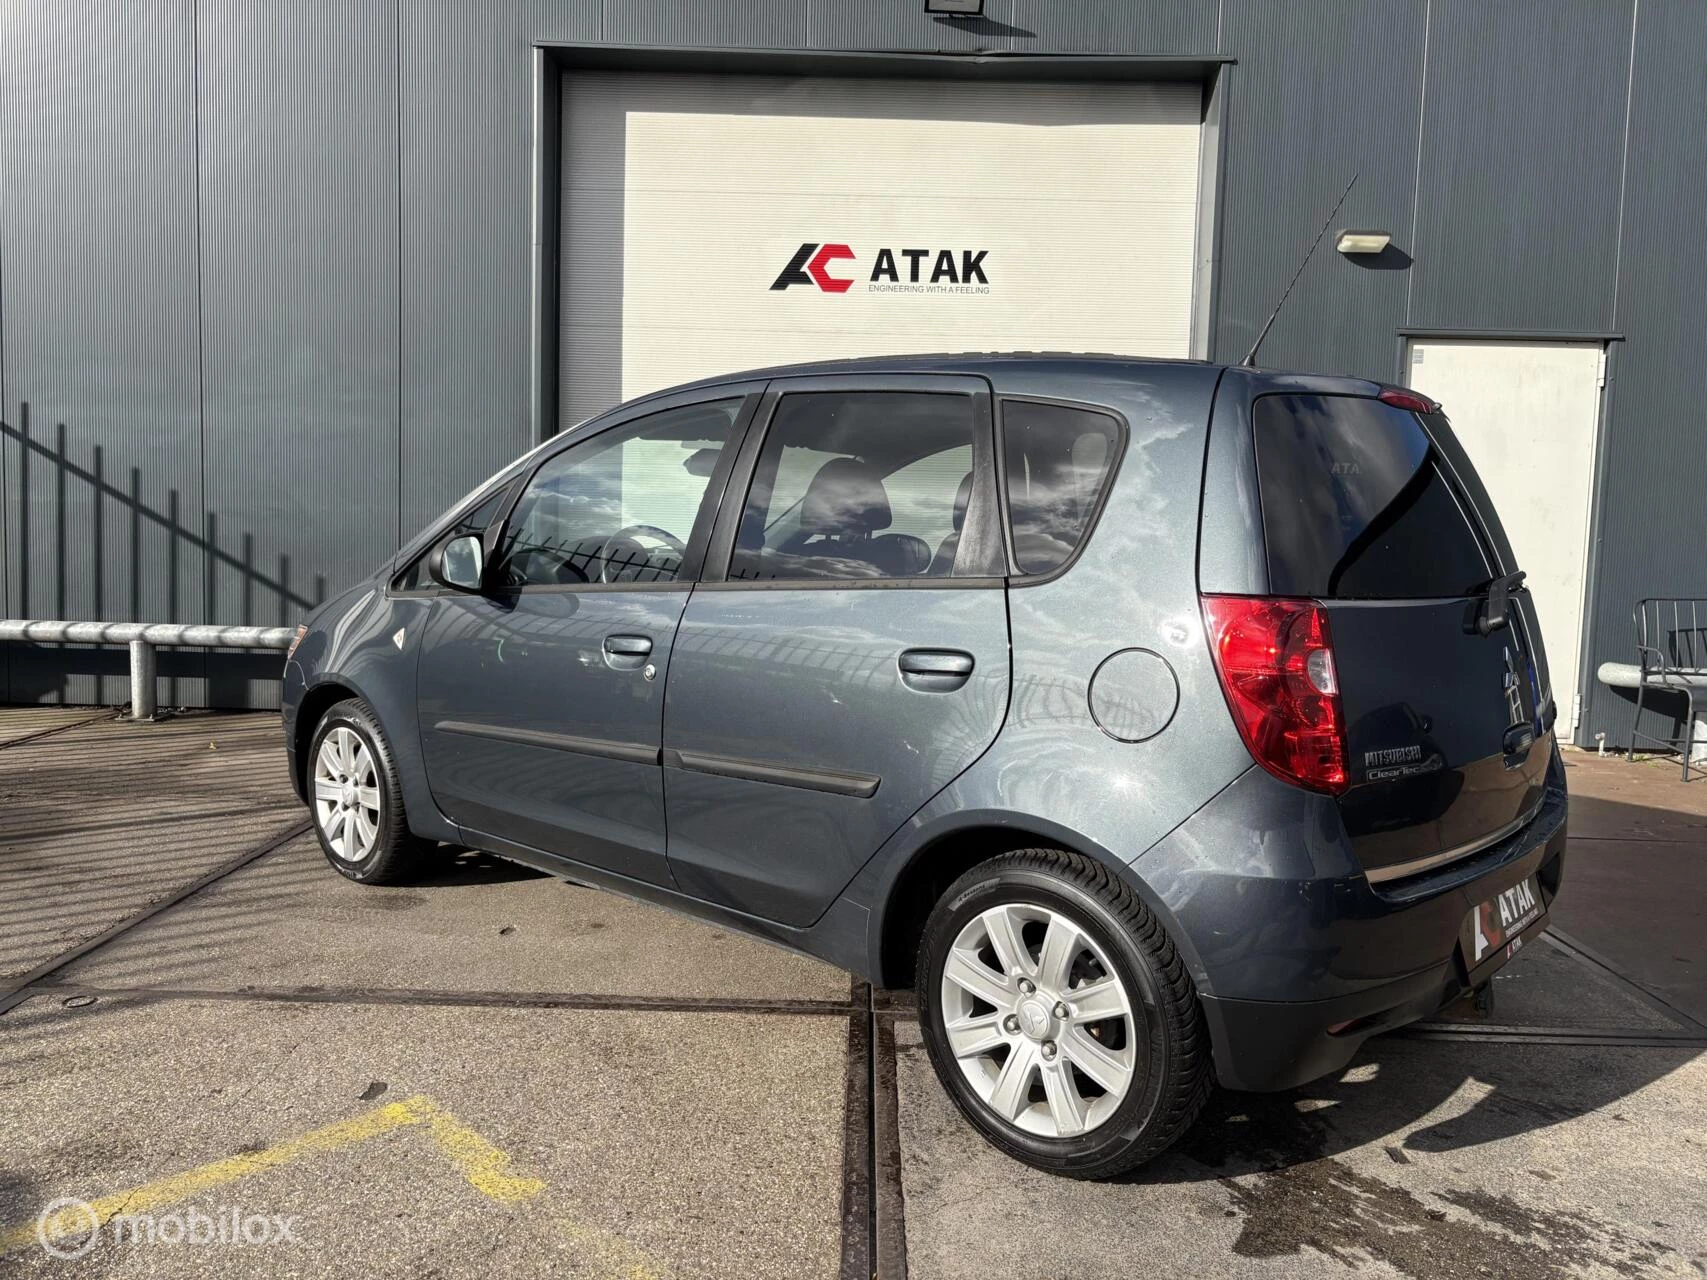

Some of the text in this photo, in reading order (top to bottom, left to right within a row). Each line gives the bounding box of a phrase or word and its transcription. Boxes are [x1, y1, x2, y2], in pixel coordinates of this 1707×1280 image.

[869, 248, 989, 284] ATAK
[868, 284, 990, 295] ENGINEERING WITH A FEELING
[1364, 745, 1421, 767] MITSUBISHI
[1368, 767, 1419, 780] ClearTec
[1498, 879, 1535, 927] ATAK
